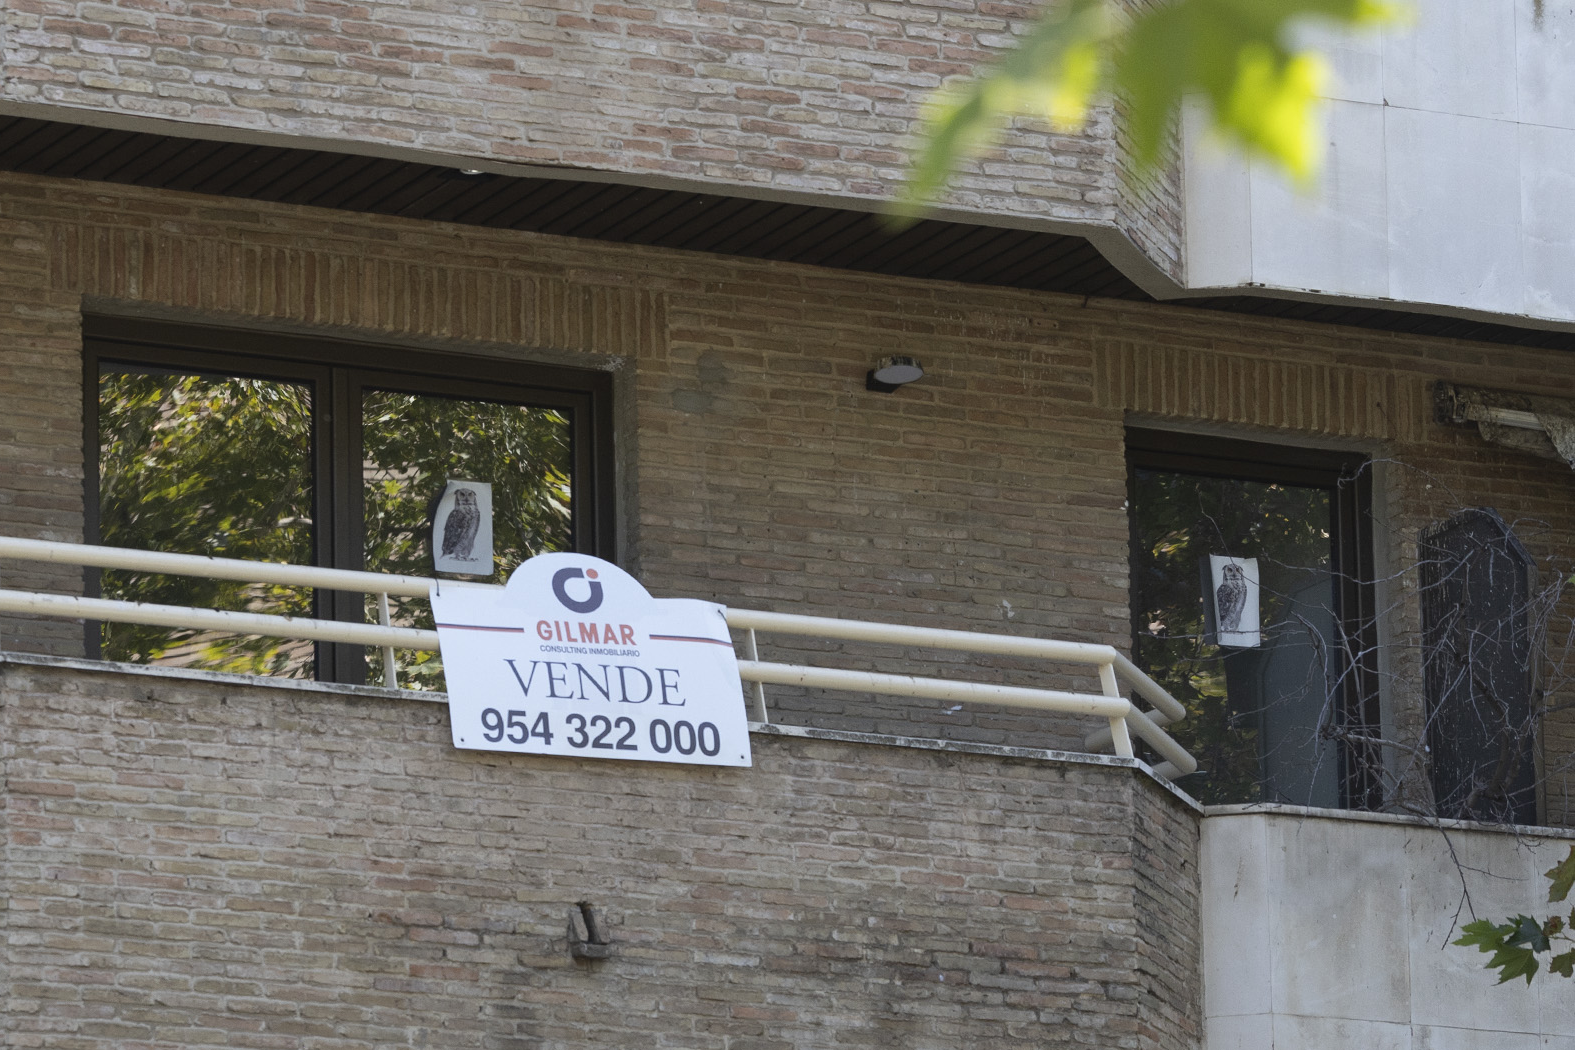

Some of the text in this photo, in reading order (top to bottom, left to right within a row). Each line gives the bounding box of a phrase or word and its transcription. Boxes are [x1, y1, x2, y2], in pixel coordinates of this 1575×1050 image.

[536, 620, 637, 646] GILMAR
[539, 645, 640, 657] CONSULTING INMOBILIARIO
[503, 659, 686, 706] VENDE
[481, 707, 720, 757] 954 322 000
